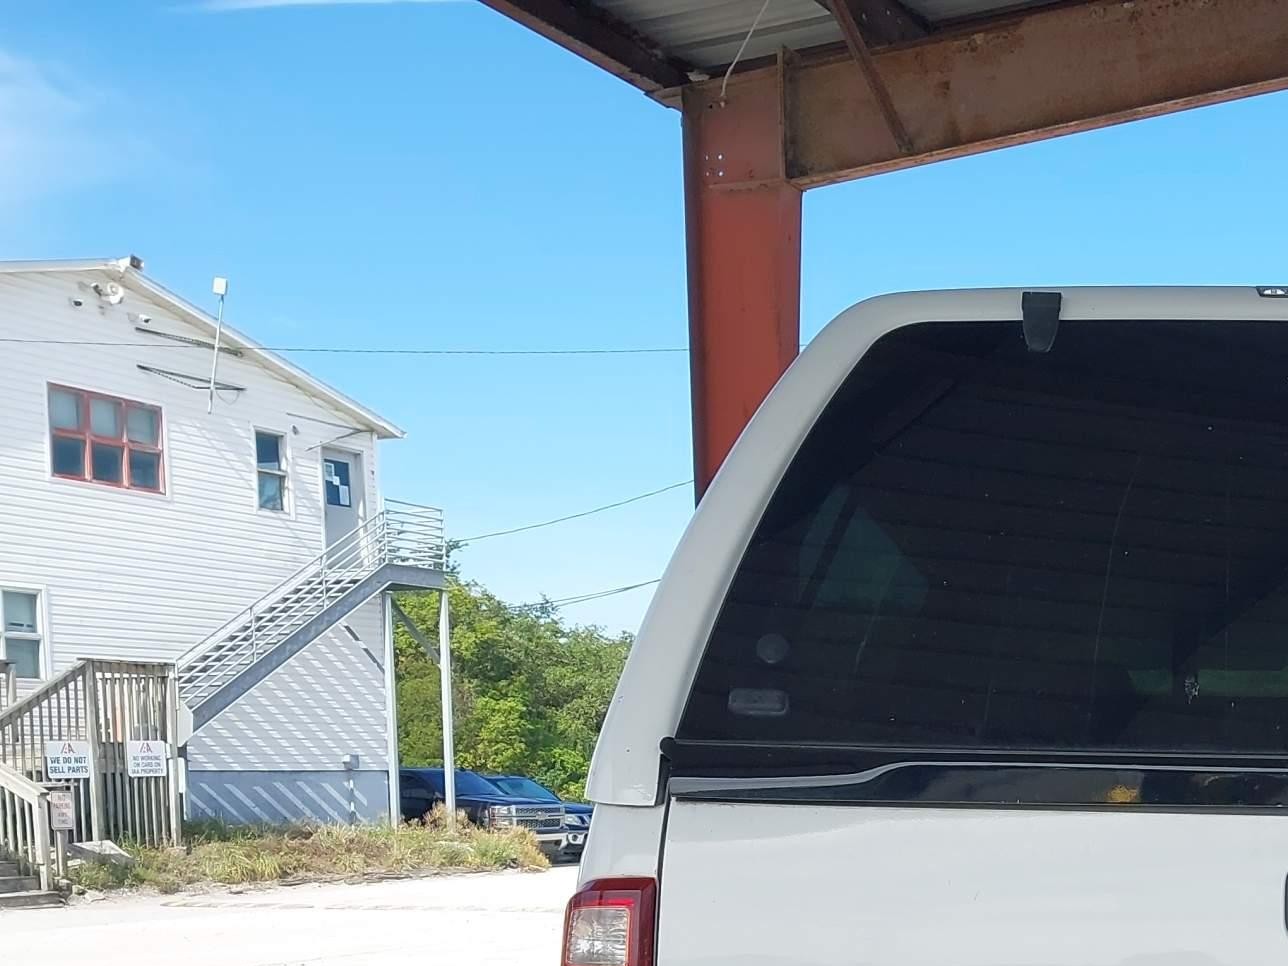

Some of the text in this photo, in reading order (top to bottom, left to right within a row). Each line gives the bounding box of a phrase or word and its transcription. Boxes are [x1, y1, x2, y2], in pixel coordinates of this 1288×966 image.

[50, 756, 87, 764] WE DO NOT
[49, 766, 89, 774] SELL PARTS
